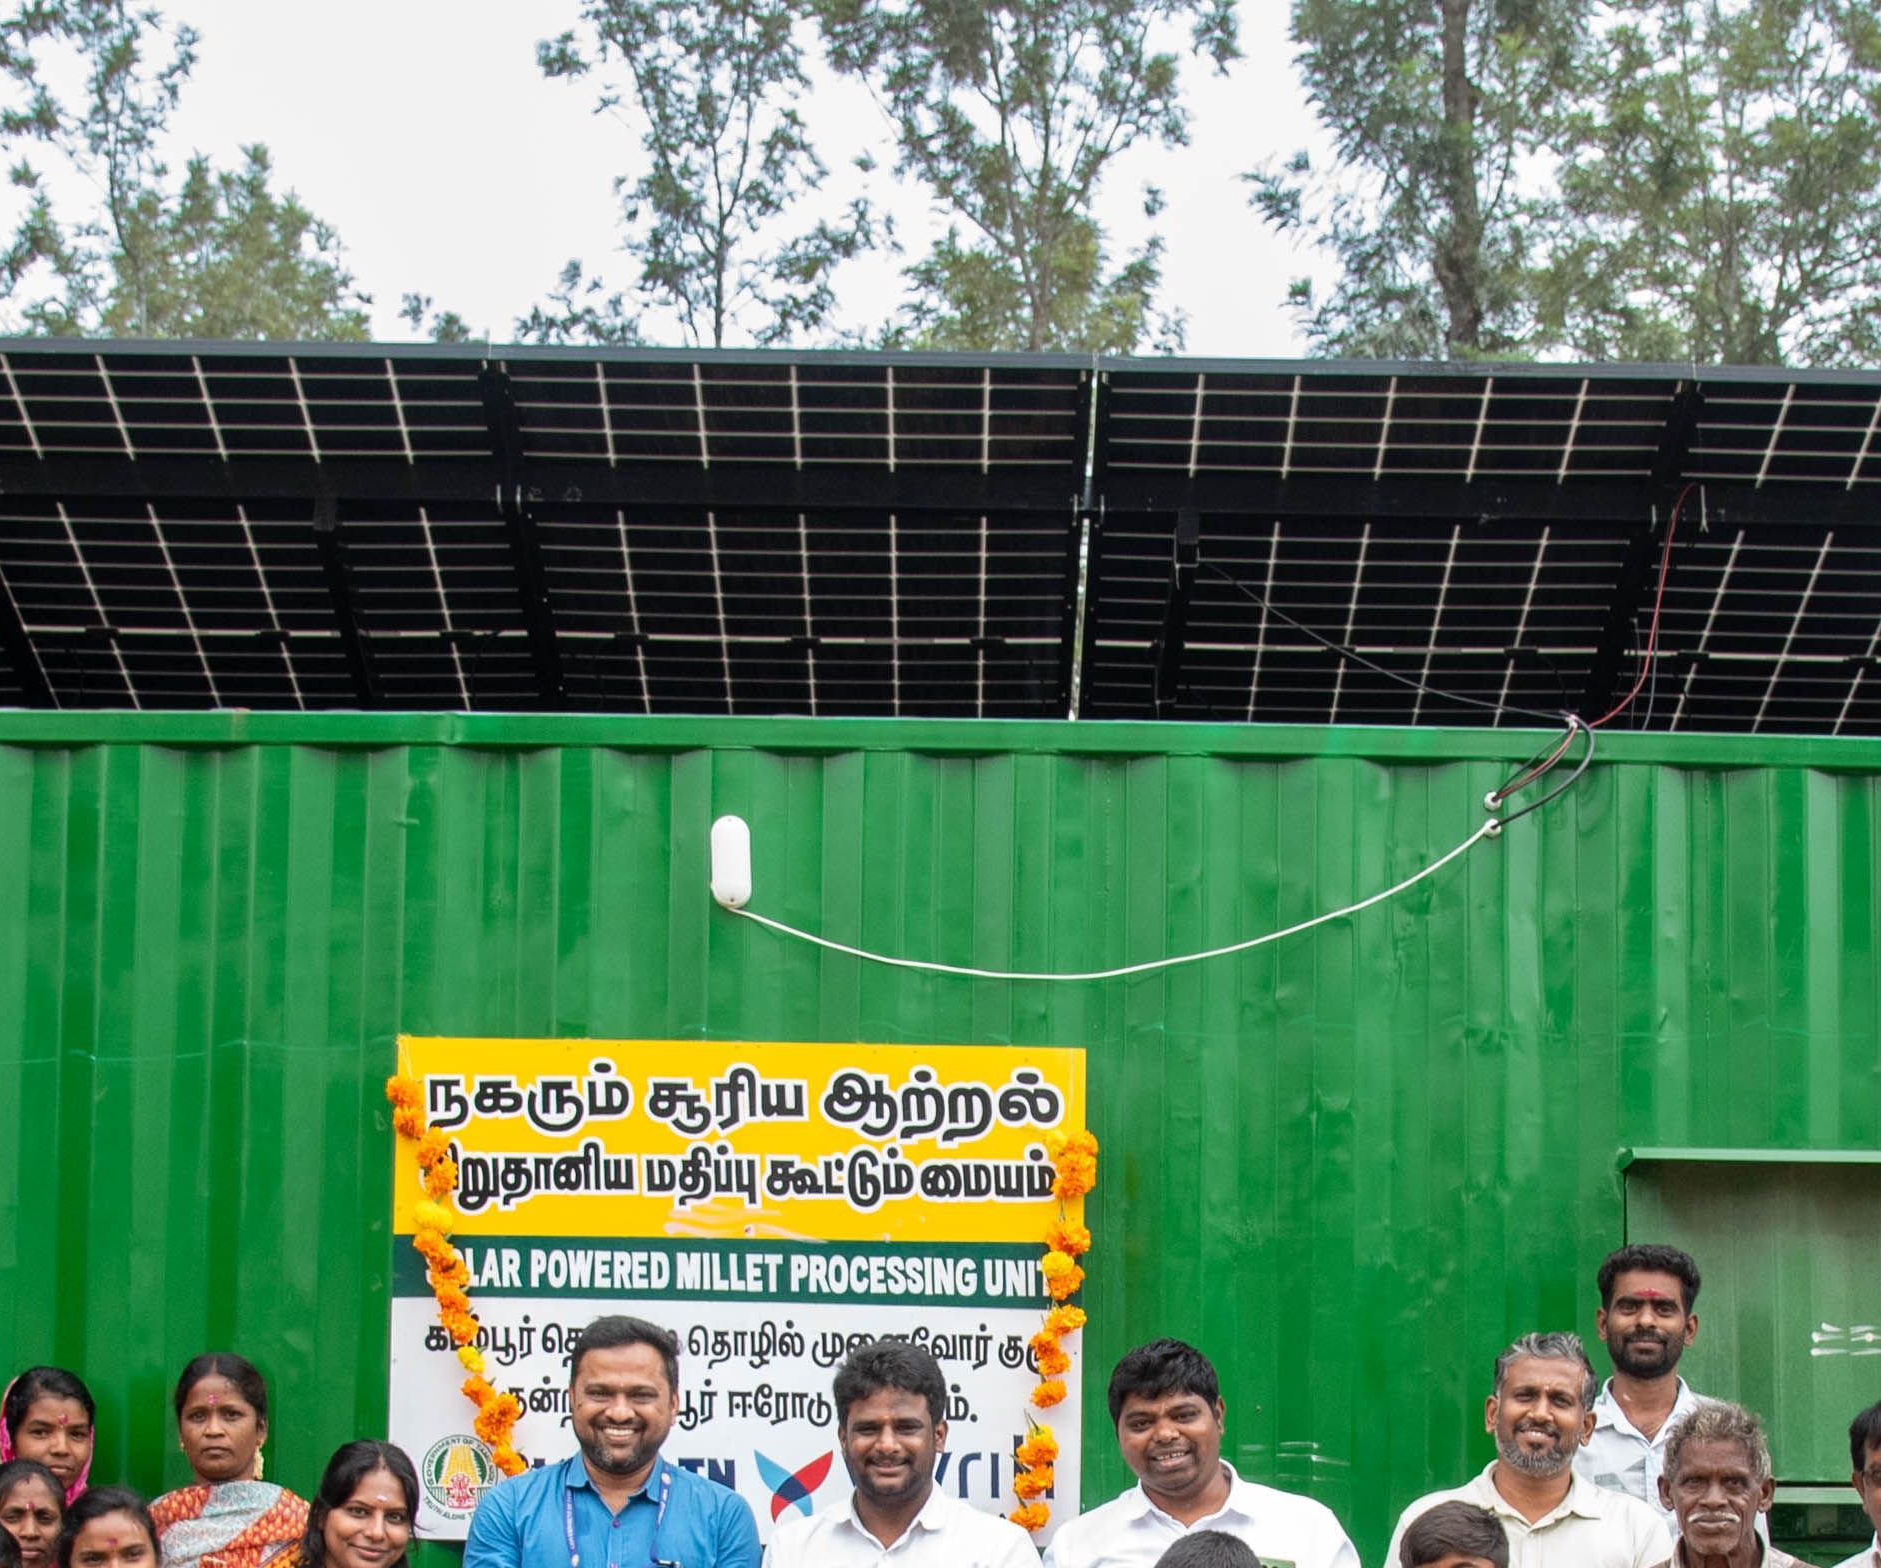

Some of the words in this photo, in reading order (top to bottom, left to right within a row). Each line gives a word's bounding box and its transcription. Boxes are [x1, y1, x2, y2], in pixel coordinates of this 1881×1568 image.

[426, 1060, 632, 1134] நகரும்
[646, 1064, 806, 1136] சூரிய
[821, 1068, 1063, 1143] ஆற்றல்
[425, 1140, 636, 1212] றுதானிய
[644, 1143, 759, 1207] மதிப்பு
[919, 1148, 1057, 1199] மையம்
[427, 1247, 523, 1290] LAR
[530, 1249, 669, 1290] POWERED
[676, 1252, 784, 1293] MILLET
[789, 1254, 979, 1297] PROCESSING
[687, 1319, 806, 1370] தொழில்
[726, 1382, 833, 1428] ஈரோடு
